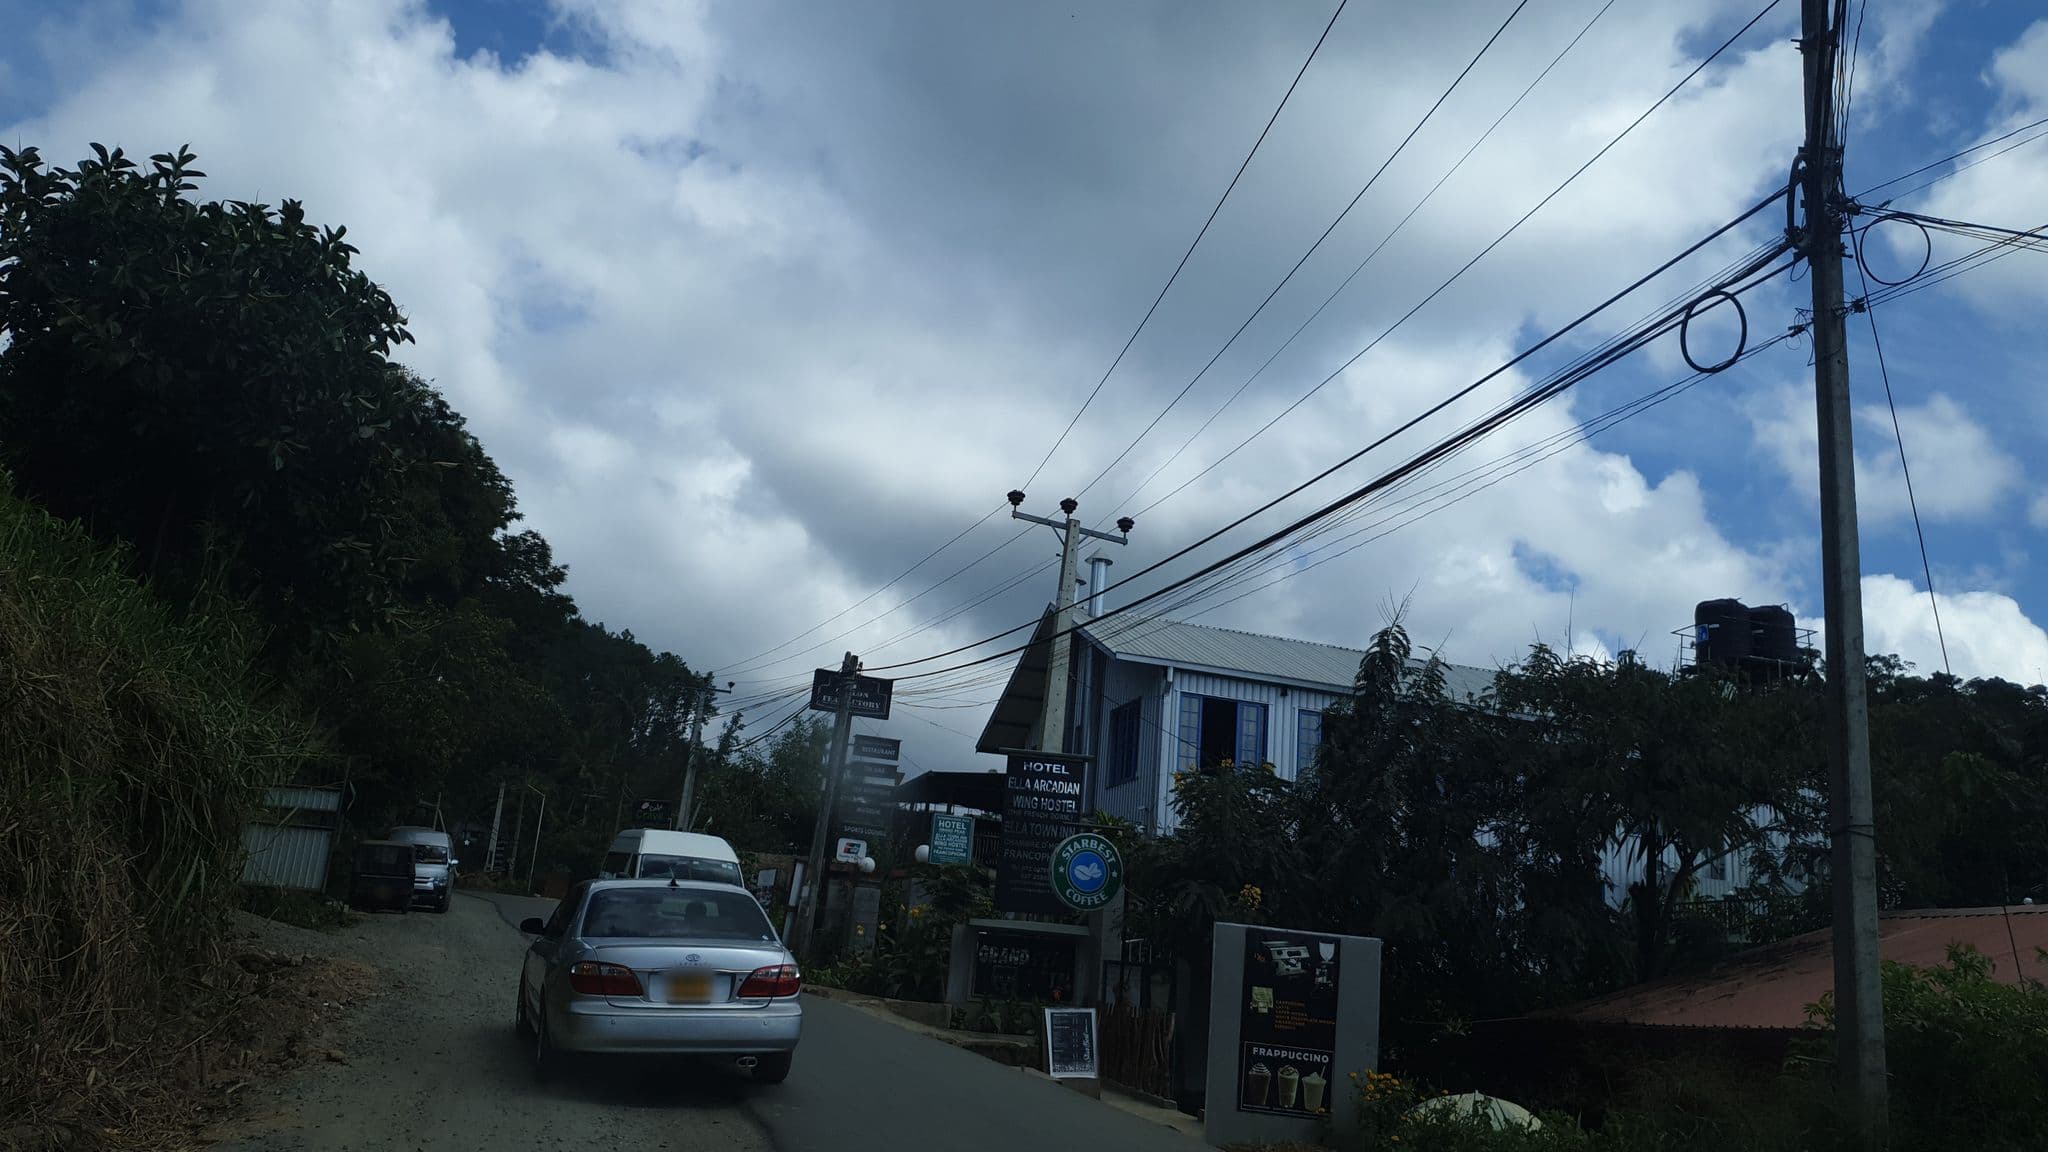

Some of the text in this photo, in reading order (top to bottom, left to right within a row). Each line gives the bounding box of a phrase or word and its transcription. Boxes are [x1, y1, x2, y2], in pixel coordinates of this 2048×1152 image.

[1023, 761, 1070, 775] HOTEL
[1008, 776, 1080, 796] ELLA ARCADIAN
[1012, 795, 1039, 810] WING
[1040, 796, 1078, 813] HOSTEL
[938, 819, 967, 831] HOTEL
[1029, 823, 1058, 838] TOWN
[1061, 838, 1117, 864] STARBEST
[1065, 888, 1109, 906] COFFEE
[1252, 1046, 1330, 1063] FRAPPUCCINO
